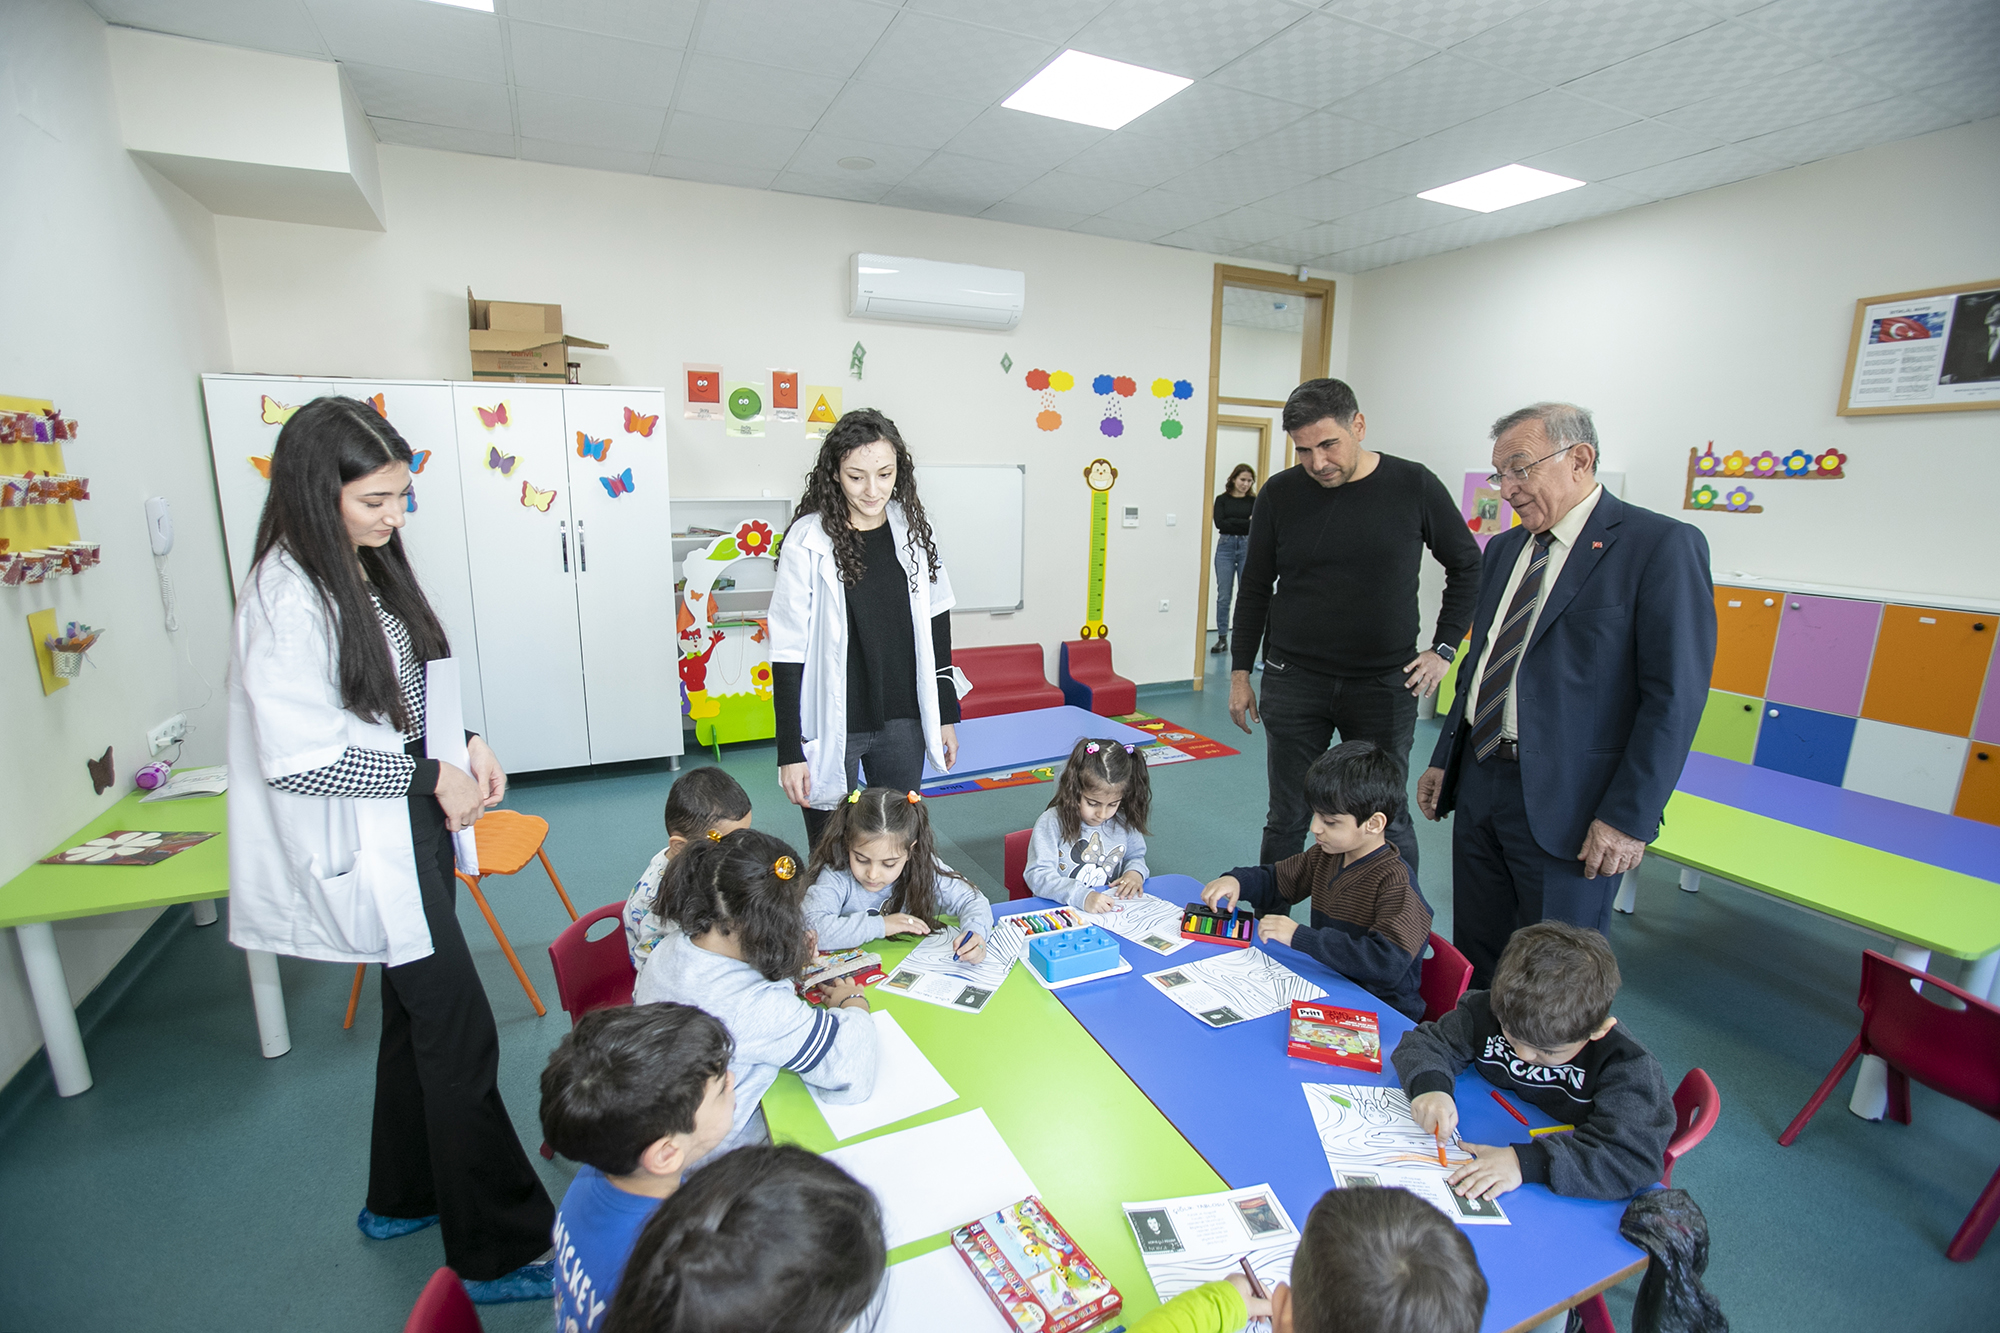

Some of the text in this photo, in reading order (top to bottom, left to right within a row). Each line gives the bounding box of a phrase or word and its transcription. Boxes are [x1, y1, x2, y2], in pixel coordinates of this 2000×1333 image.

[1300, 1009, 1321, 1017] Pritt
[976, 1233, 998, 1254] BOYA
[553, 1211, 607, 1331] MICKEY
[990, 1253, 1011, 1273] MUM
[1004, 1268, 1031, 1298] JUMBO
